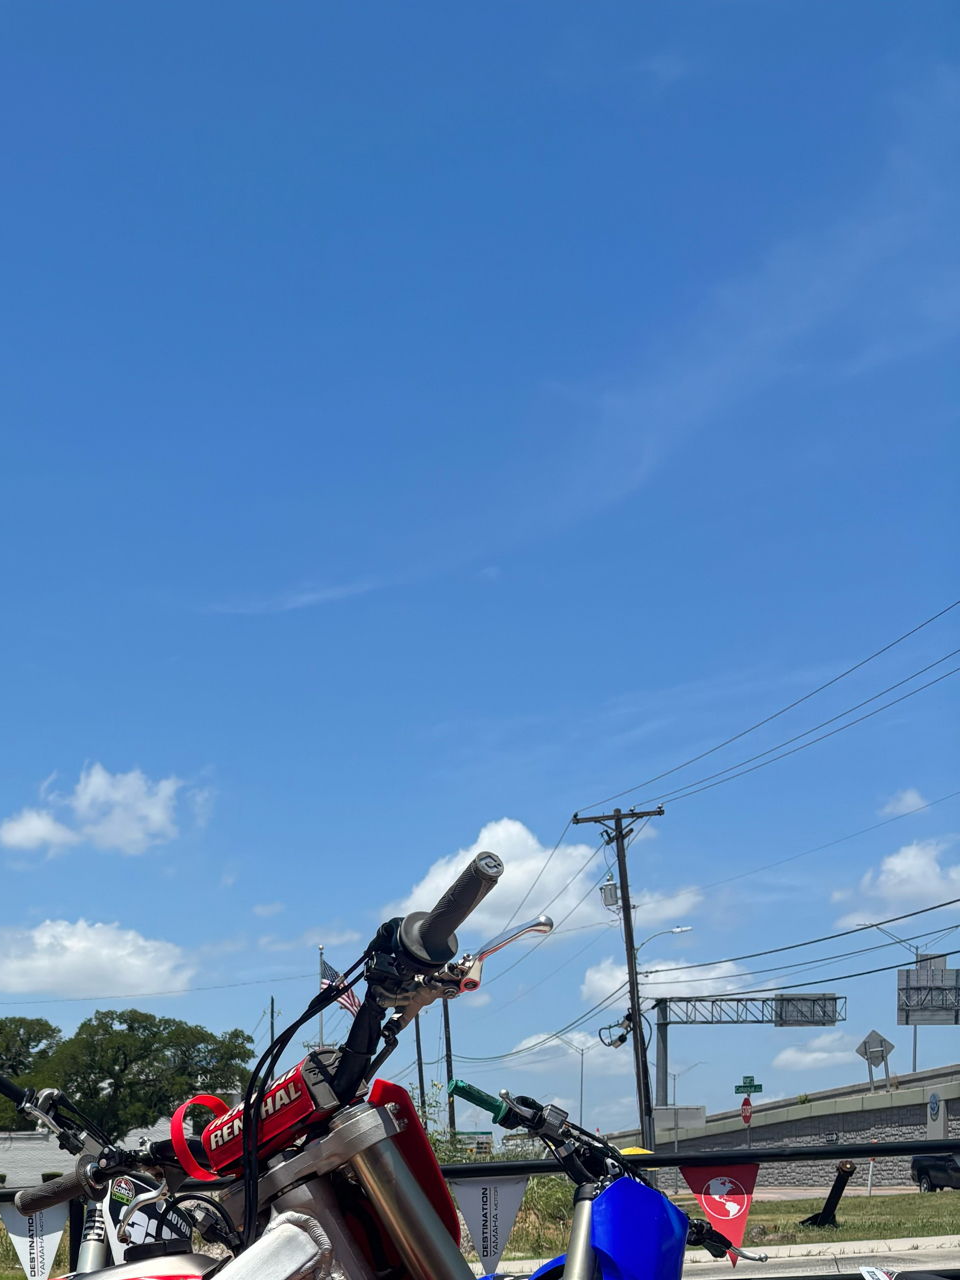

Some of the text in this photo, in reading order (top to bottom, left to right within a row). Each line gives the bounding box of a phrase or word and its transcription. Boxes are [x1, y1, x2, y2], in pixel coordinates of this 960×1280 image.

[742, 1105, 752, 1116] STOP
[481, 1187, 489, 1258] DESTINATION
[38, 1233, 46, 1277] YAMAHA
